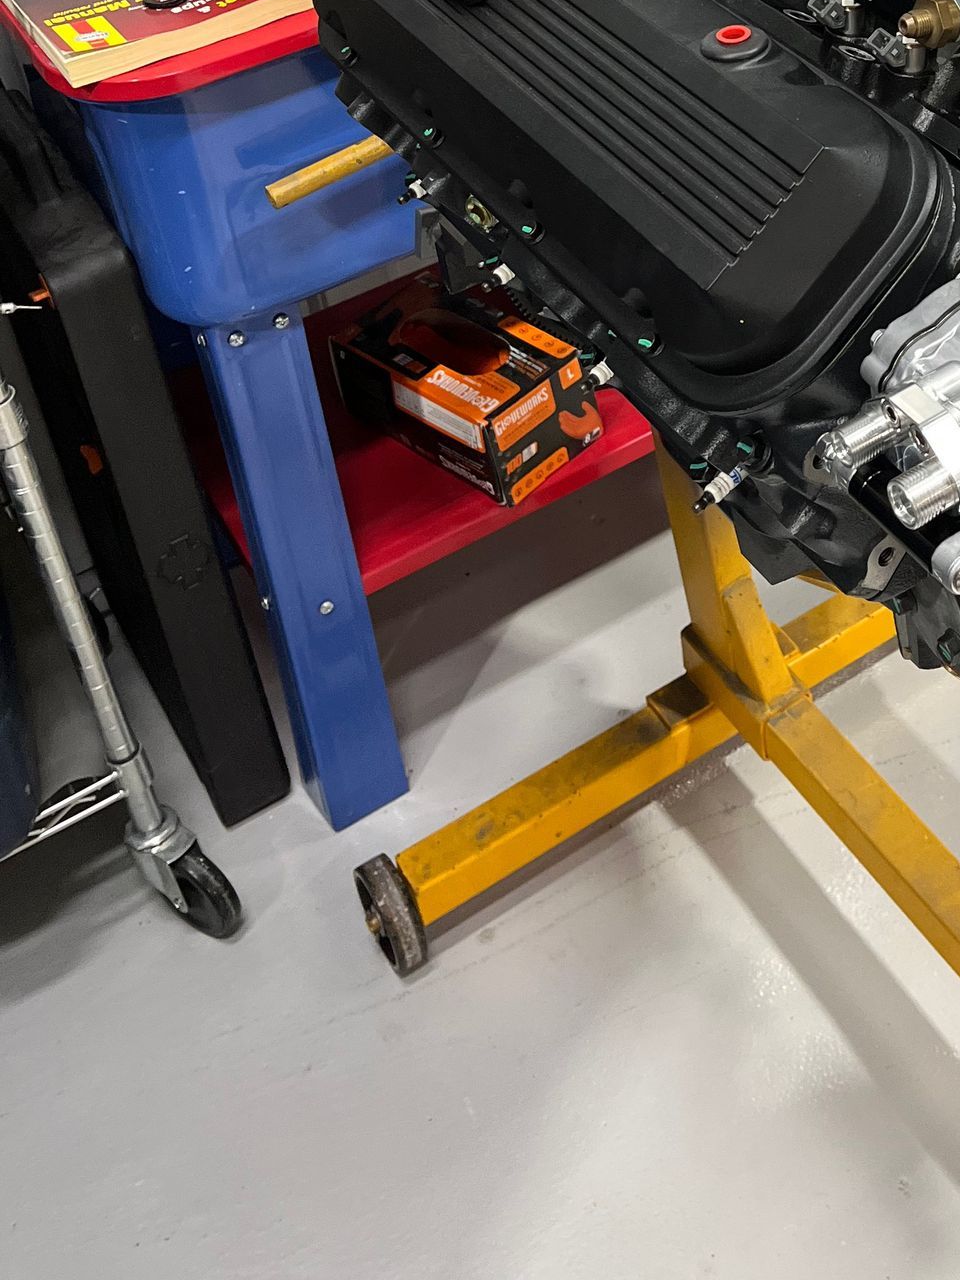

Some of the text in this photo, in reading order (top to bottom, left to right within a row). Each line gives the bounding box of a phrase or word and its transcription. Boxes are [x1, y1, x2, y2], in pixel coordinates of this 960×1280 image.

[43, 0, 130, 26] Manual
[426, 369, 499, 414] GLOVEWORKS
[493, 386, 549, 438] GLOVEWORKS
